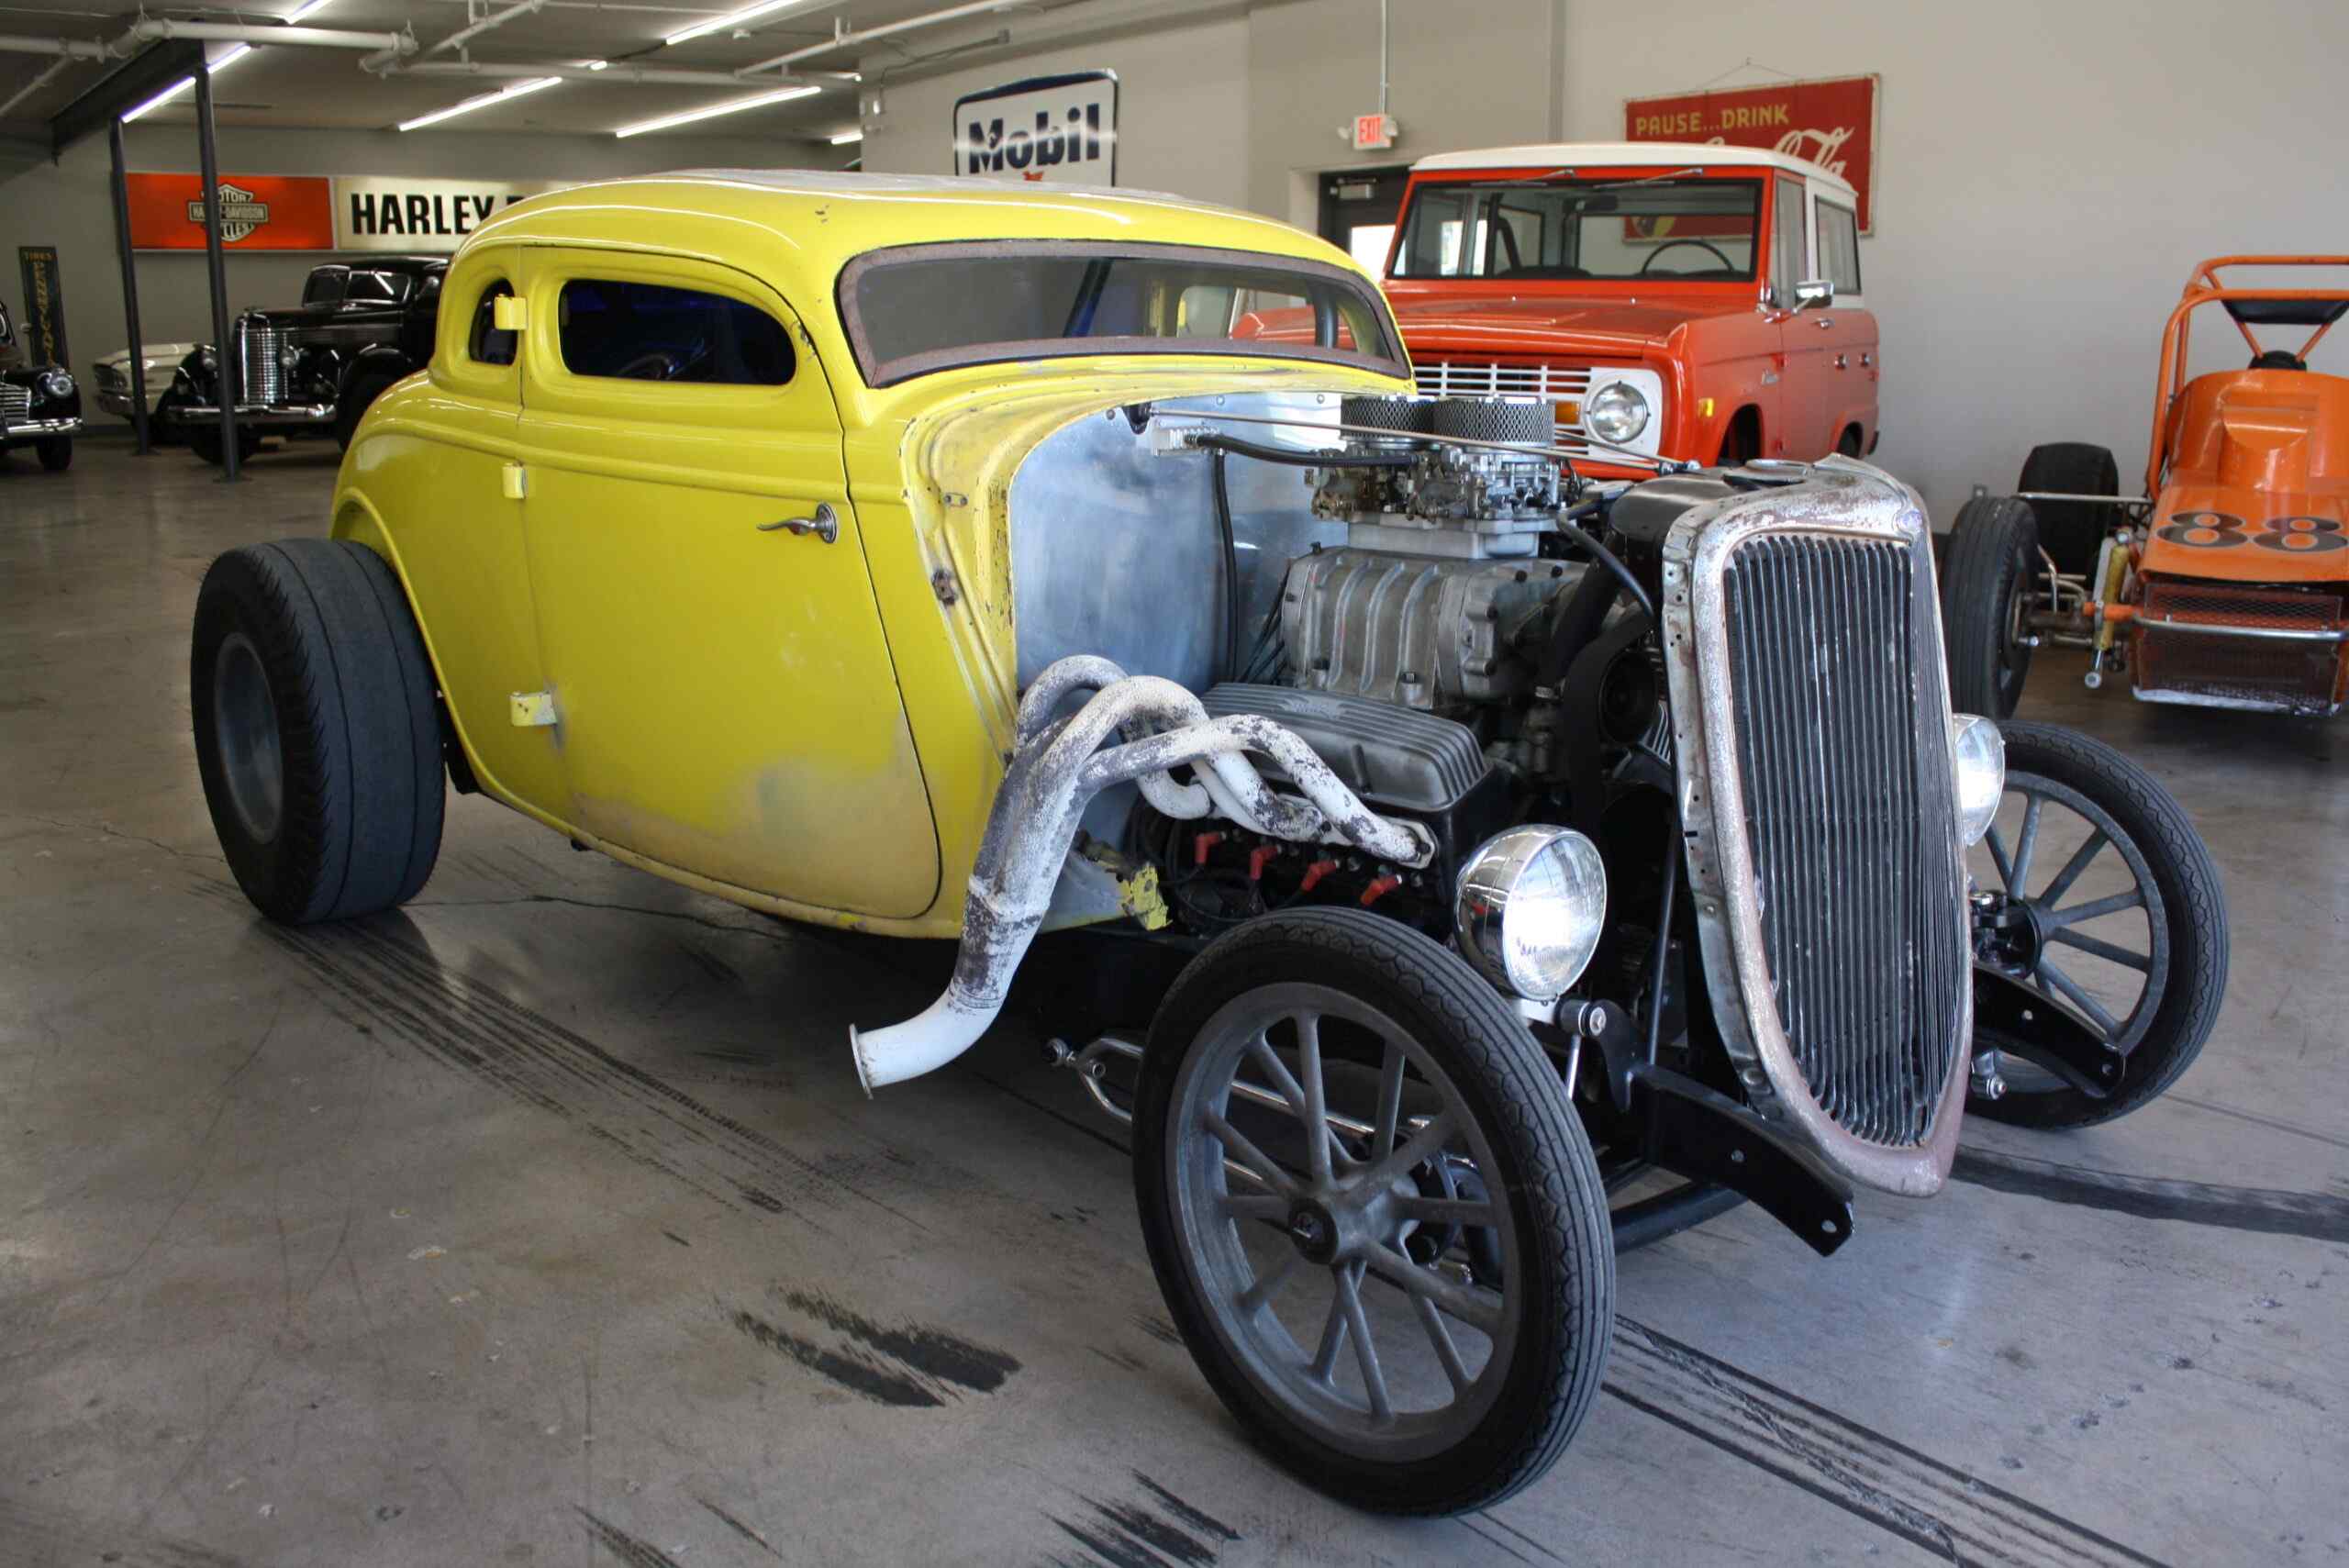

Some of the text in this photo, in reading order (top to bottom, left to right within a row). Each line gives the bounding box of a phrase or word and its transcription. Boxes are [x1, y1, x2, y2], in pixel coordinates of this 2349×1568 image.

[968, 102, 1100, 174] Mobil
[351, 193, 495, 235] HARLEY
[2156, 511, 2349, 552] 88
